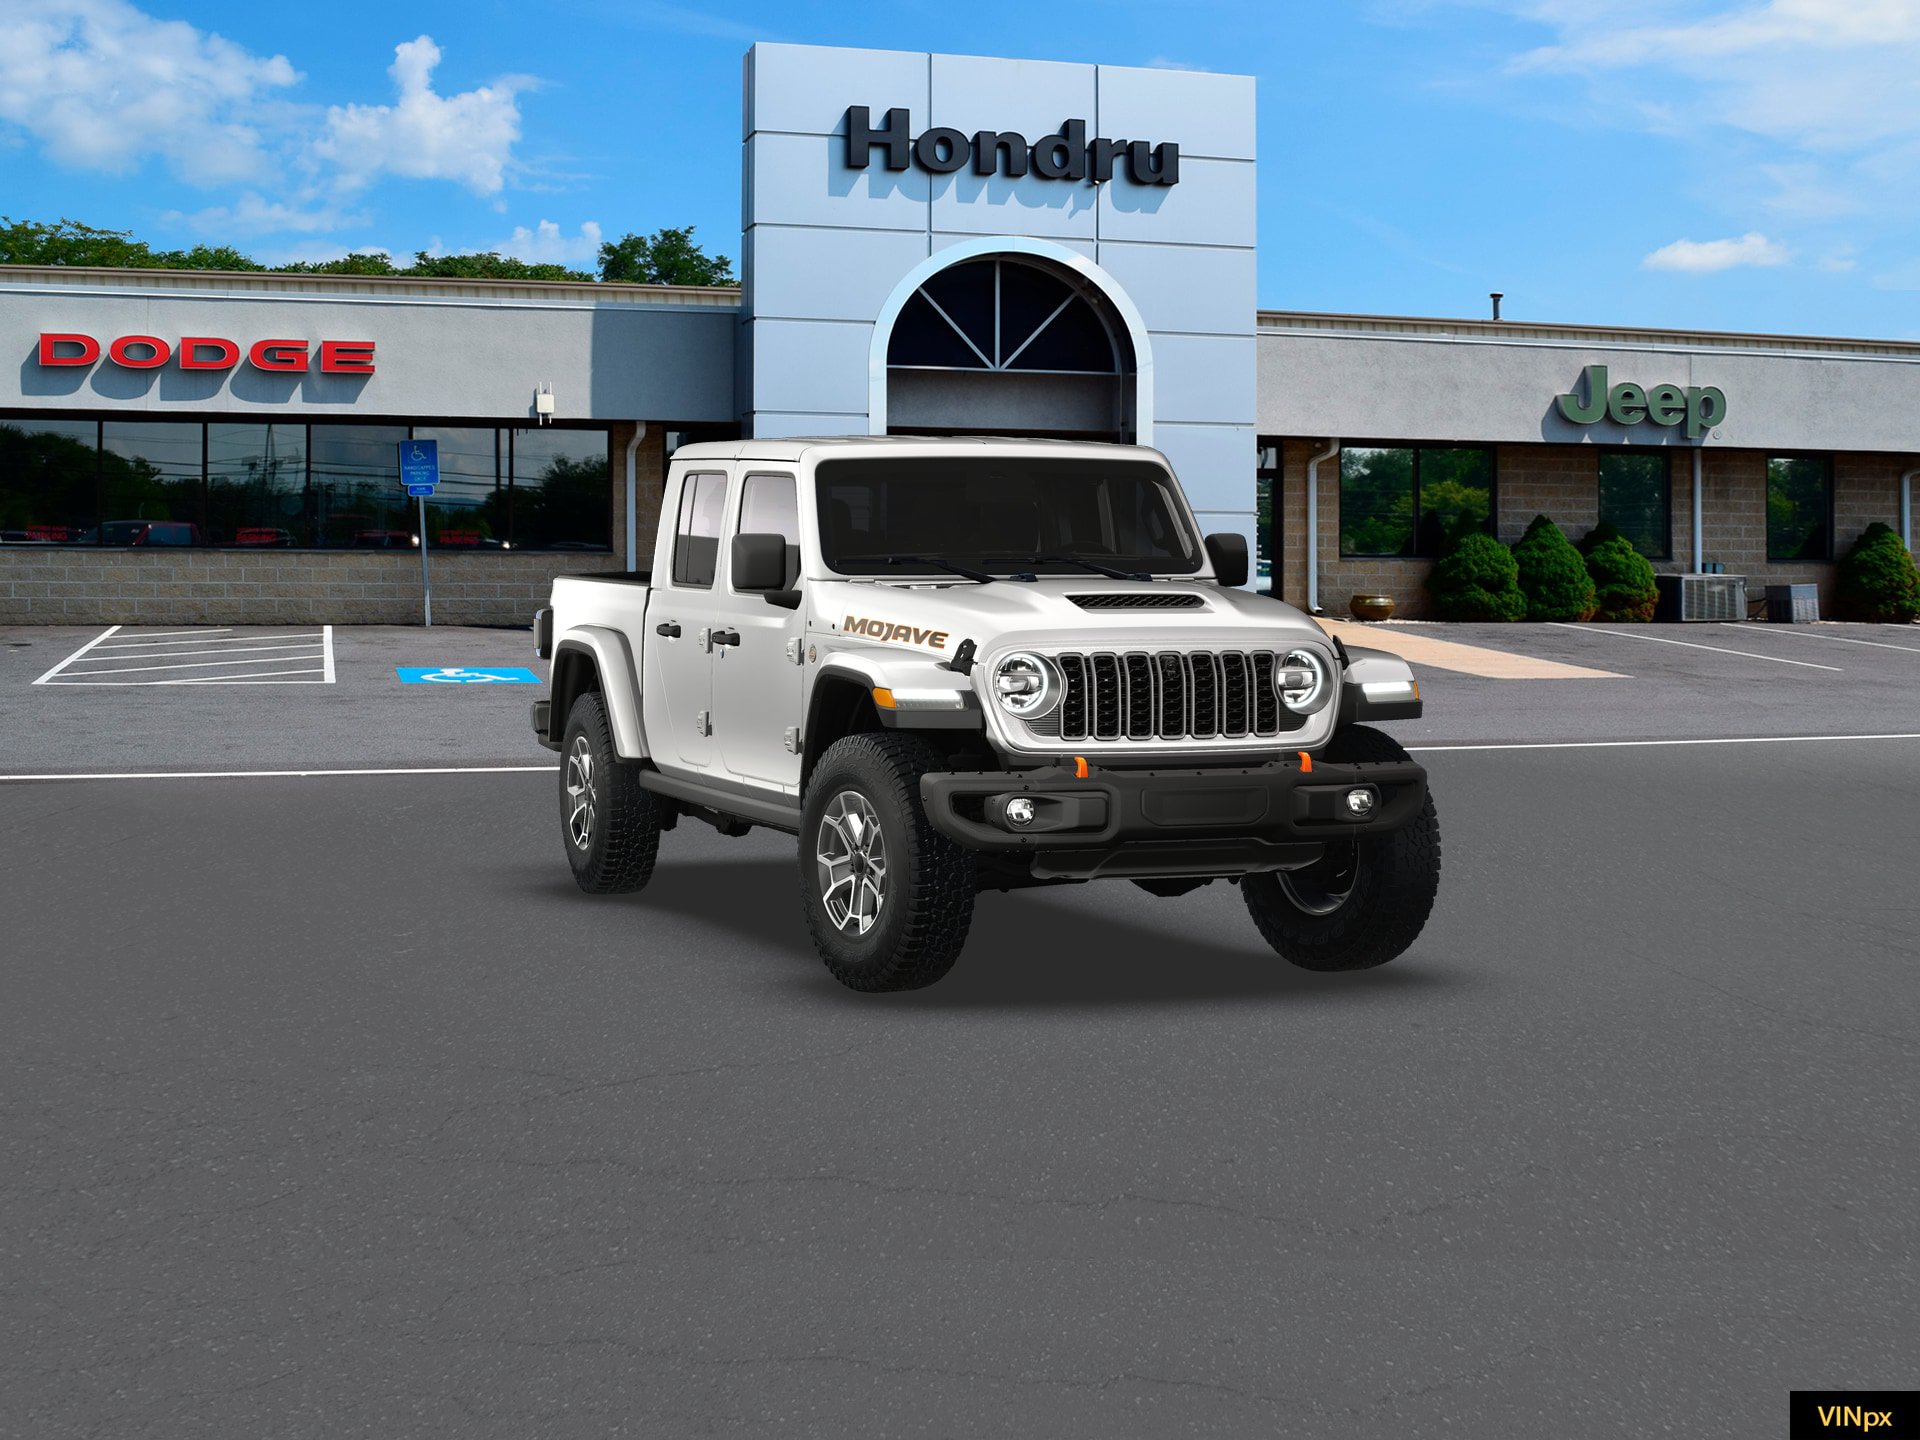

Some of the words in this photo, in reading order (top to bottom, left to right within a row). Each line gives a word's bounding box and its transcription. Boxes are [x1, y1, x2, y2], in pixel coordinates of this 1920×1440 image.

[847, 105, 1179, 186] Hondru
[39, 333, 375, 373] DODGE
[1556, 365, 1726, 438] Jeep
[844, 616, 949, 649] MOJAVE
